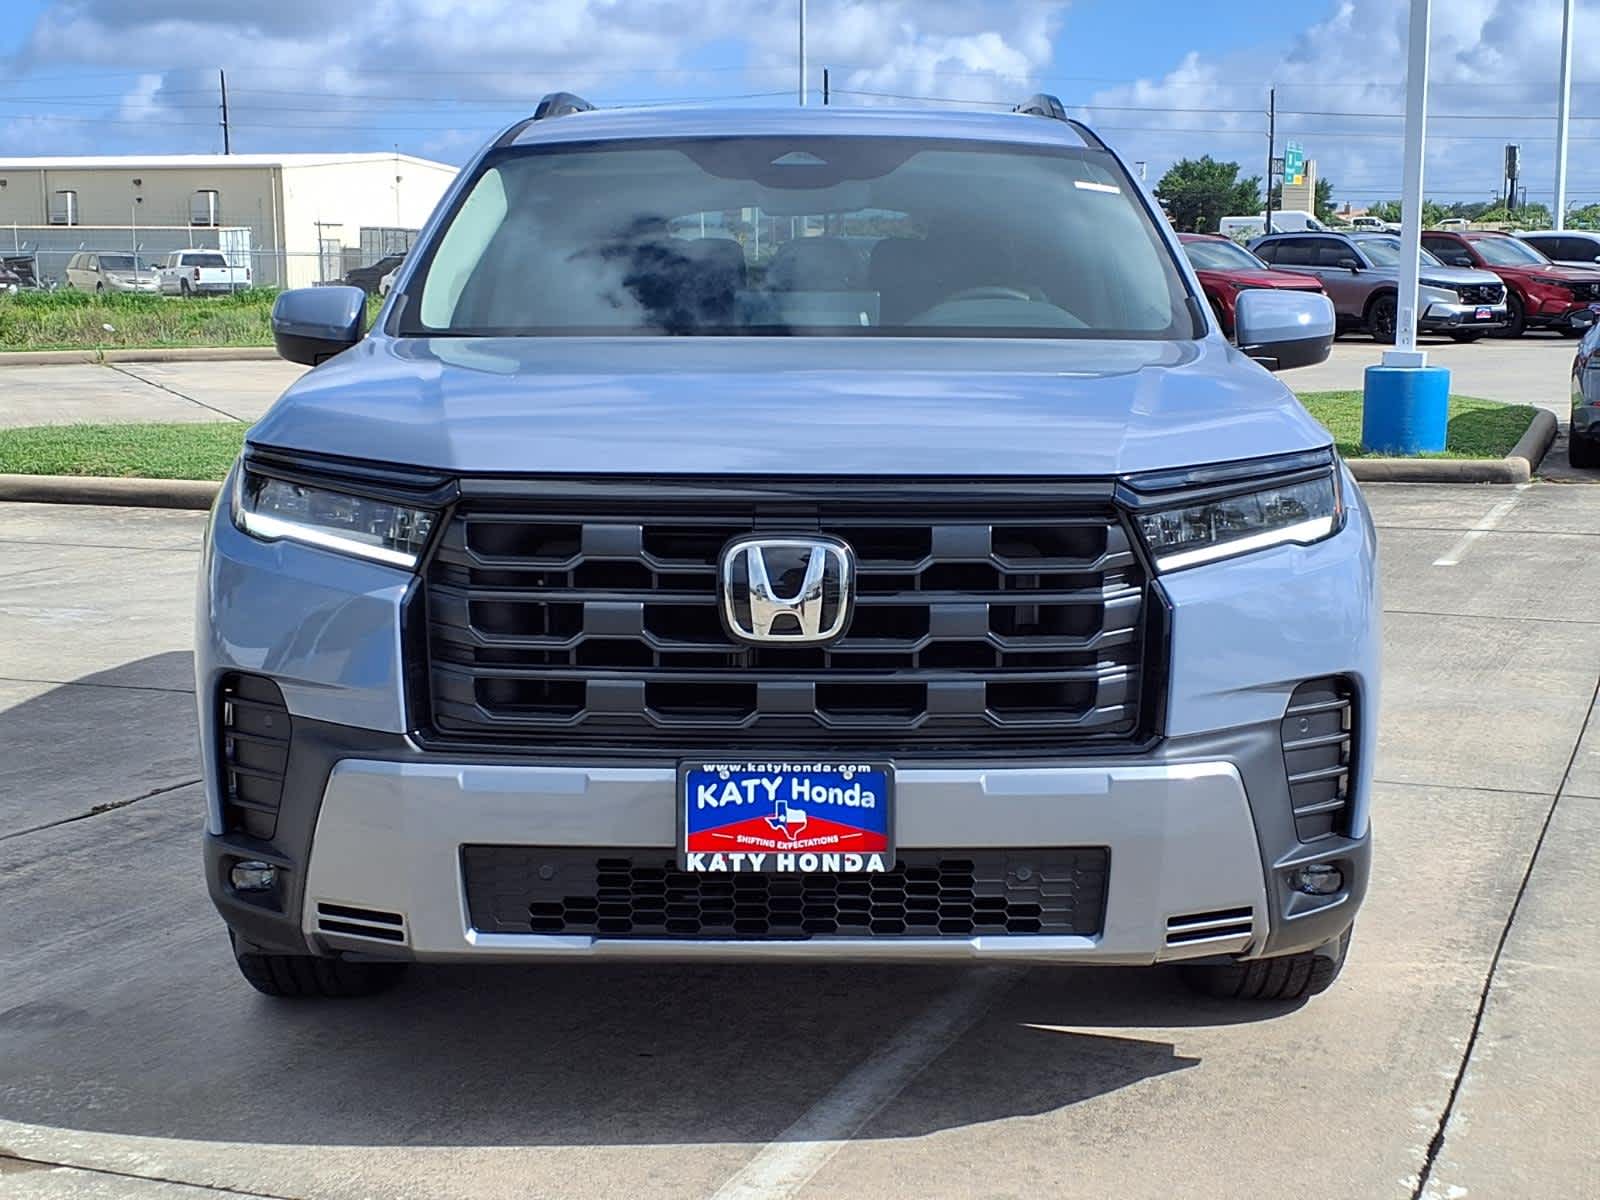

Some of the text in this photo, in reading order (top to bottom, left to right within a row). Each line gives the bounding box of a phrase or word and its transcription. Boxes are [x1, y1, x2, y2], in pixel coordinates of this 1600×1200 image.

[703, 763, 871, 773] www.katyhonda.com
[697, 776, 876, 809] KATY Honda
[736, 835, 839, 850] SHIFTING EXPECTATIONS
[687, 853, 885, 872] KATY HONDA
